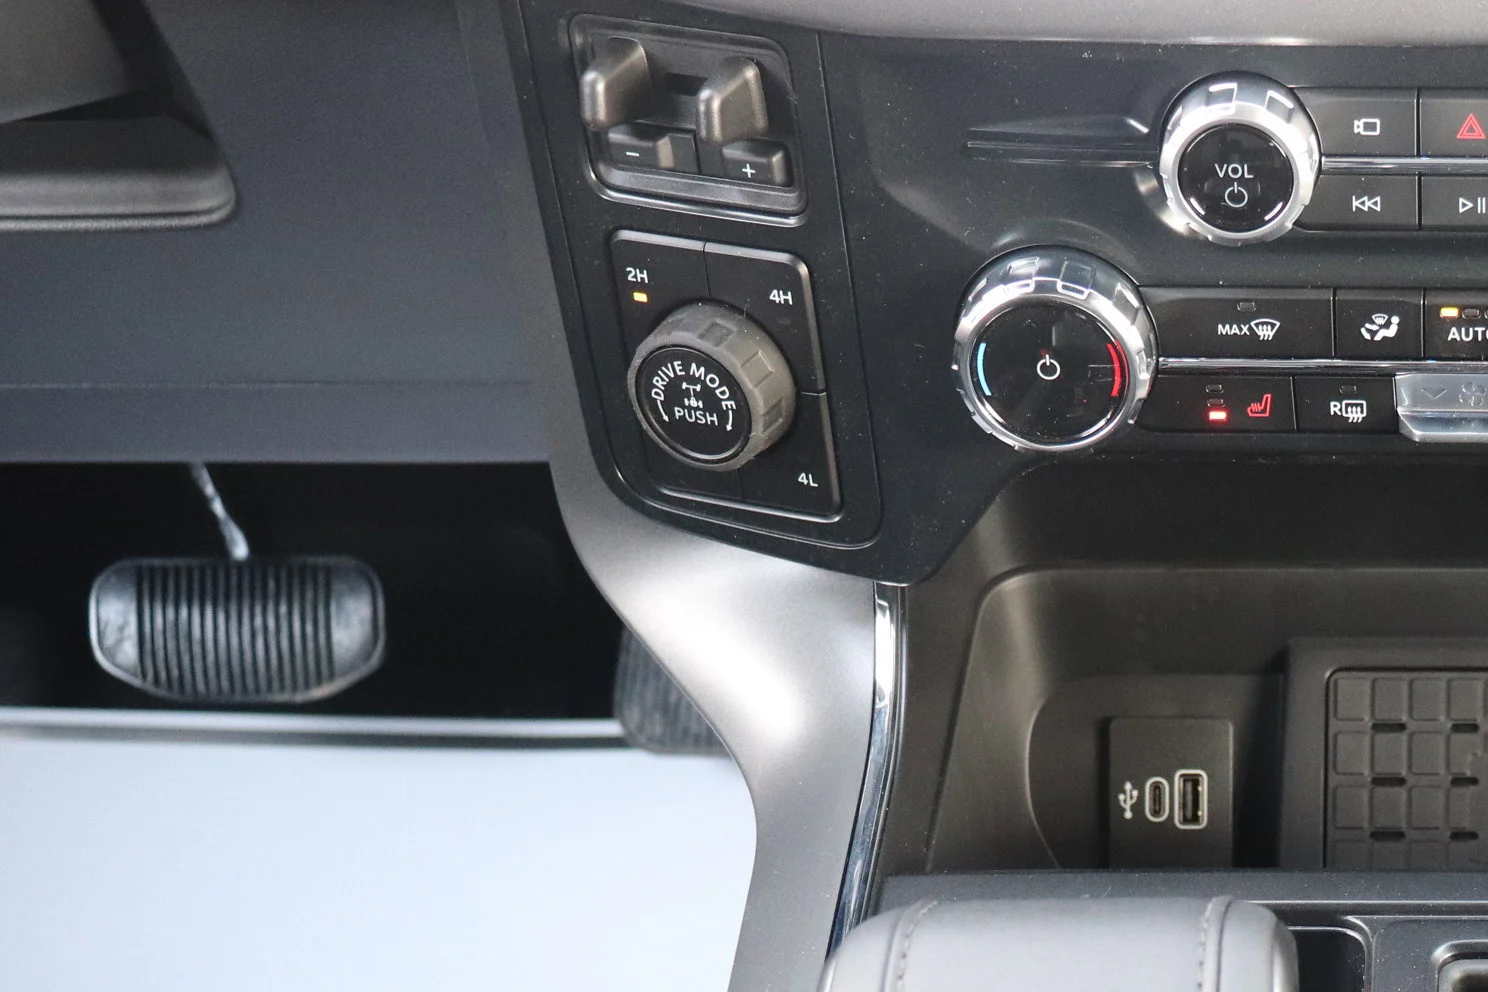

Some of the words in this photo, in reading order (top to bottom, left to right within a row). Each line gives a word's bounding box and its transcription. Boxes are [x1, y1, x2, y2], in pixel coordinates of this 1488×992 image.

[1214, 163, 1255, 180] VOL
[625, 267, 649, 285] 2H
[769, 289, 793, 306] 4H
[1217, 323, 1250, 337] MAX
[651, 360, 686, 401] DRIVE
[689, 362, 736, 411] MODE
[673, 406, 719, 426] PUSH
[797, 472, 819, 488] 4L
